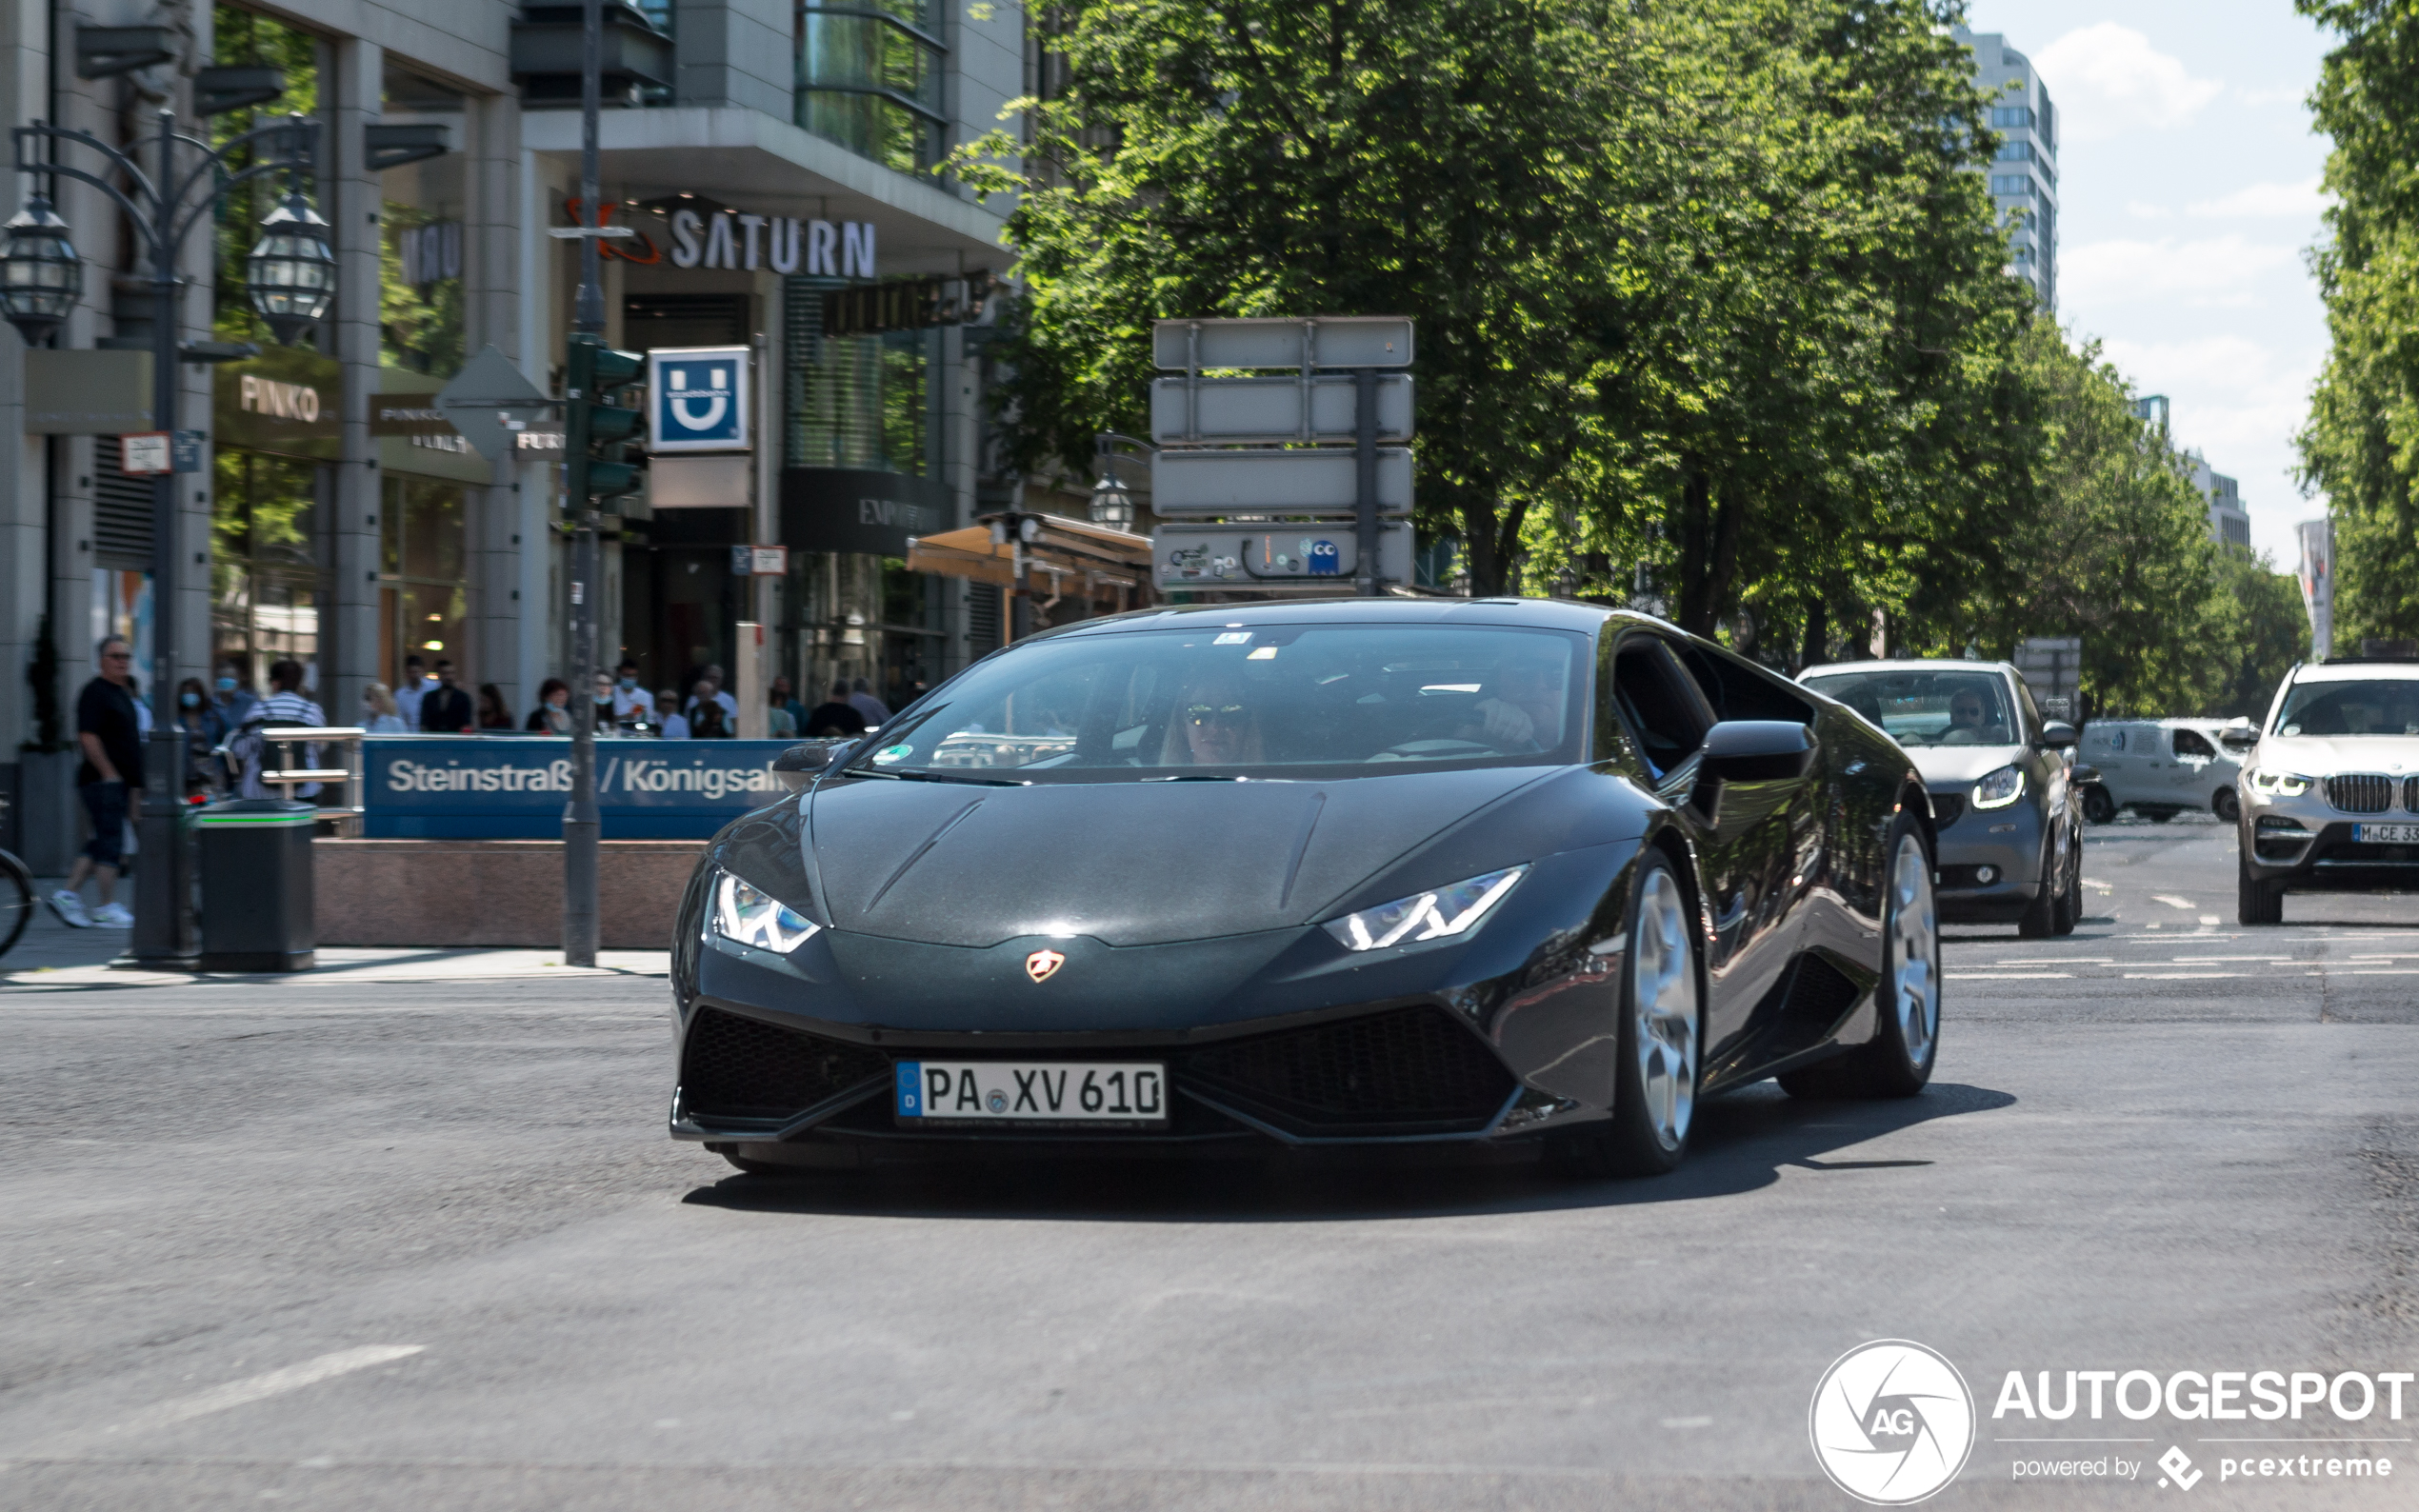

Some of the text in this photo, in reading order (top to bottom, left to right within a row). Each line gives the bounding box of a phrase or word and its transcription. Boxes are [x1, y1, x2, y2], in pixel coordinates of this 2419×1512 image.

[670, 209, 875, 278] SATURN
[241, 374, 319, 423] PINKO
[388, 760, 574, 791] Steinstraß
[2362, 826, 2371, 841] M
[2380, 826, 2398, 841] CE
[926, 1068, 1160, 1114] PA XV 610
